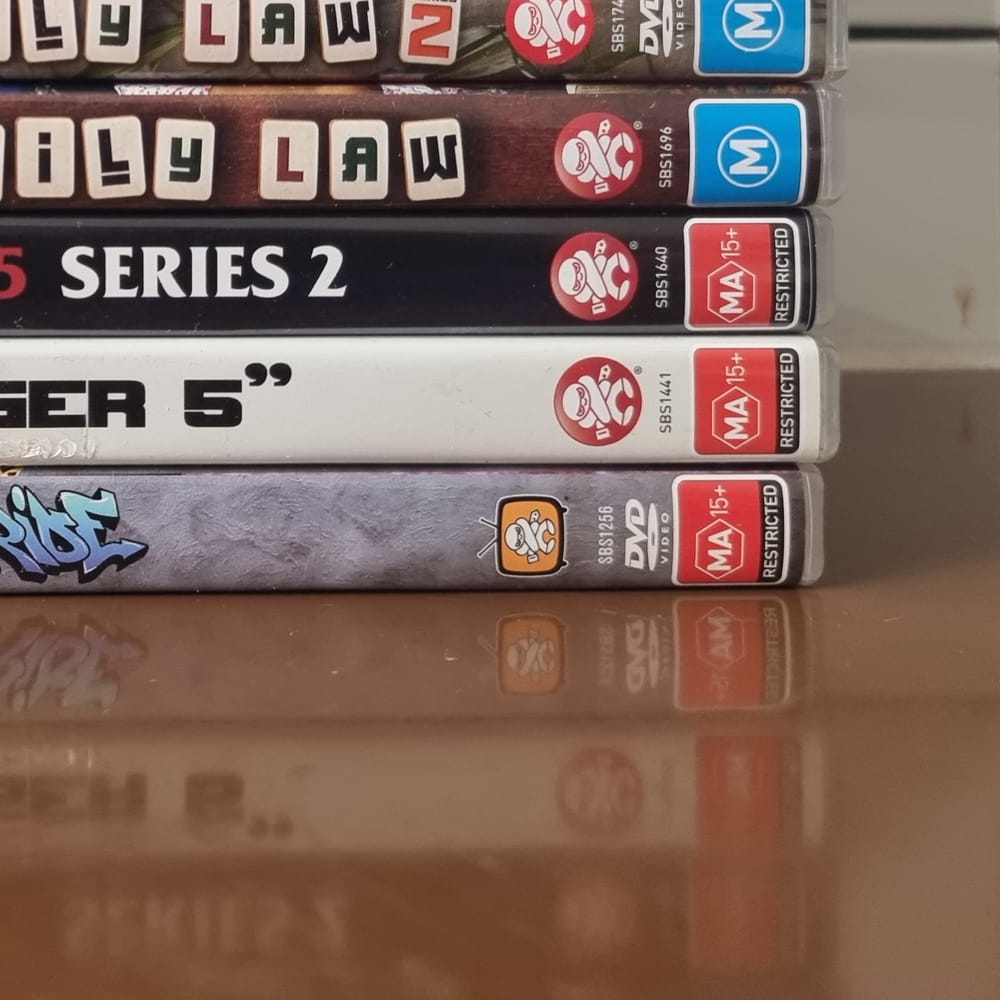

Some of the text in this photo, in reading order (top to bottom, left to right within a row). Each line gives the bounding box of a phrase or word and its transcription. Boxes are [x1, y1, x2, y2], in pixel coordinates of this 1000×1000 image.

[407, 3, 454, 59] 2
[734, 2, 773, 38] M
[273, 131, 461, 185] LAW
[659, 126, 672, 188] SBS1696
[729, 139, 768, 175] M
[60, 244, 290, 299] SERIES
[308, 245, 347, 297] 2
[655, 246, 668, 309] SBS1640
[719, 227, 745, 314] MA 15+
[774, 227, 788, 323] RESTRICTED
[659, 372, 672, 434] SBS1441
[723, 352, 750, 440] MA 15+
[779, 351, 794, 449] RESTRICTED
[598, 505, 614, 565] SBS1256
[624, 499, 647, 570] DVD
[660, 512, 669, 564] VIDEO
[706, 485, 734, 571] MA 15+
[763, 484, 777, 578] RESTRICTED
